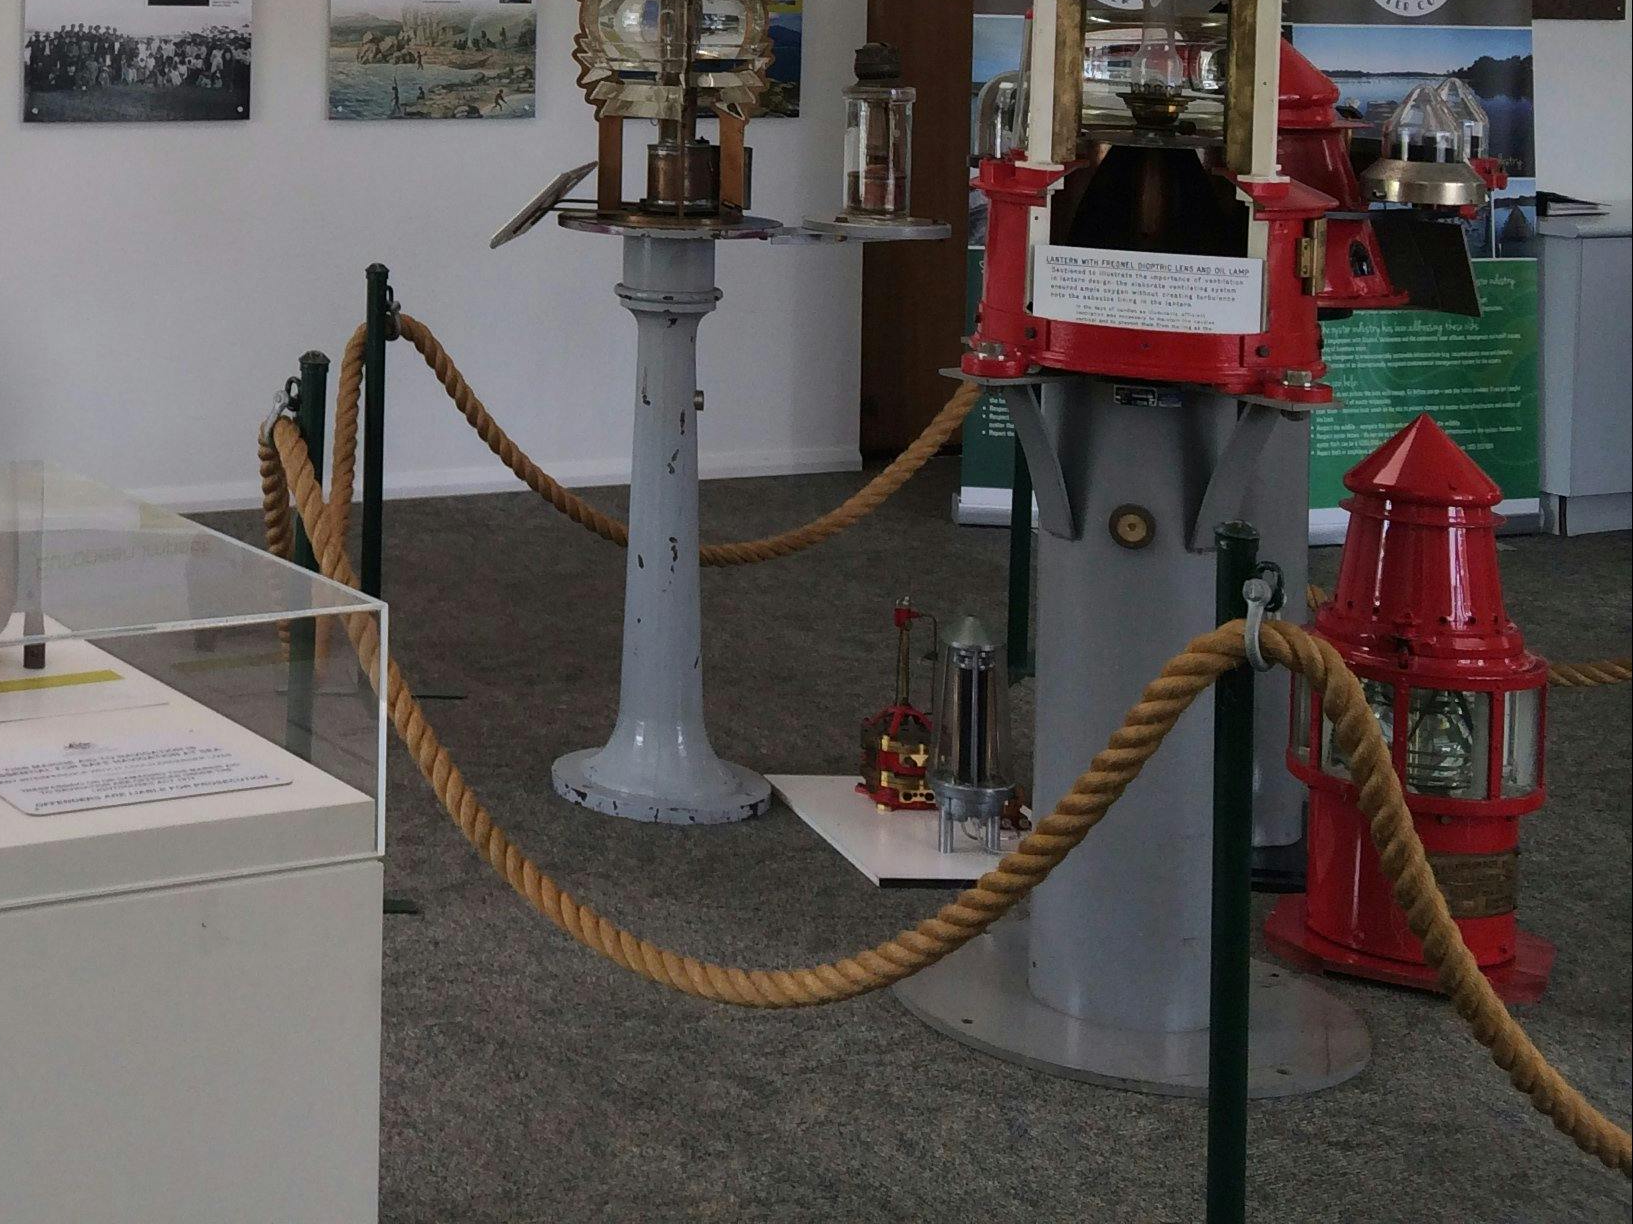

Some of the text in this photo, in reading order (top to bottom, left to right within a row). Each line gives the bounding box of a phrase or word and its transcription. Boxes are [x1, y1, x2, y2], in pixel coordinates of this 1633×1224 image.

[1046, 255, 1250, 276] LANTERN WITH FRESNEL DIOPTRIC LENS AND OIL LAMP
[1150, 275, 1190, 283] importance
[1205, 278, 1244, 286] ventilation
[1131, 282, 1166, 290] elaborate
[1169, 284, 1208, 293] ventilating
[1103, 287, 1129, 295] oxygen
[1131, 289, 1159, 297] without
[1162, 292, 1193, 301] creating
